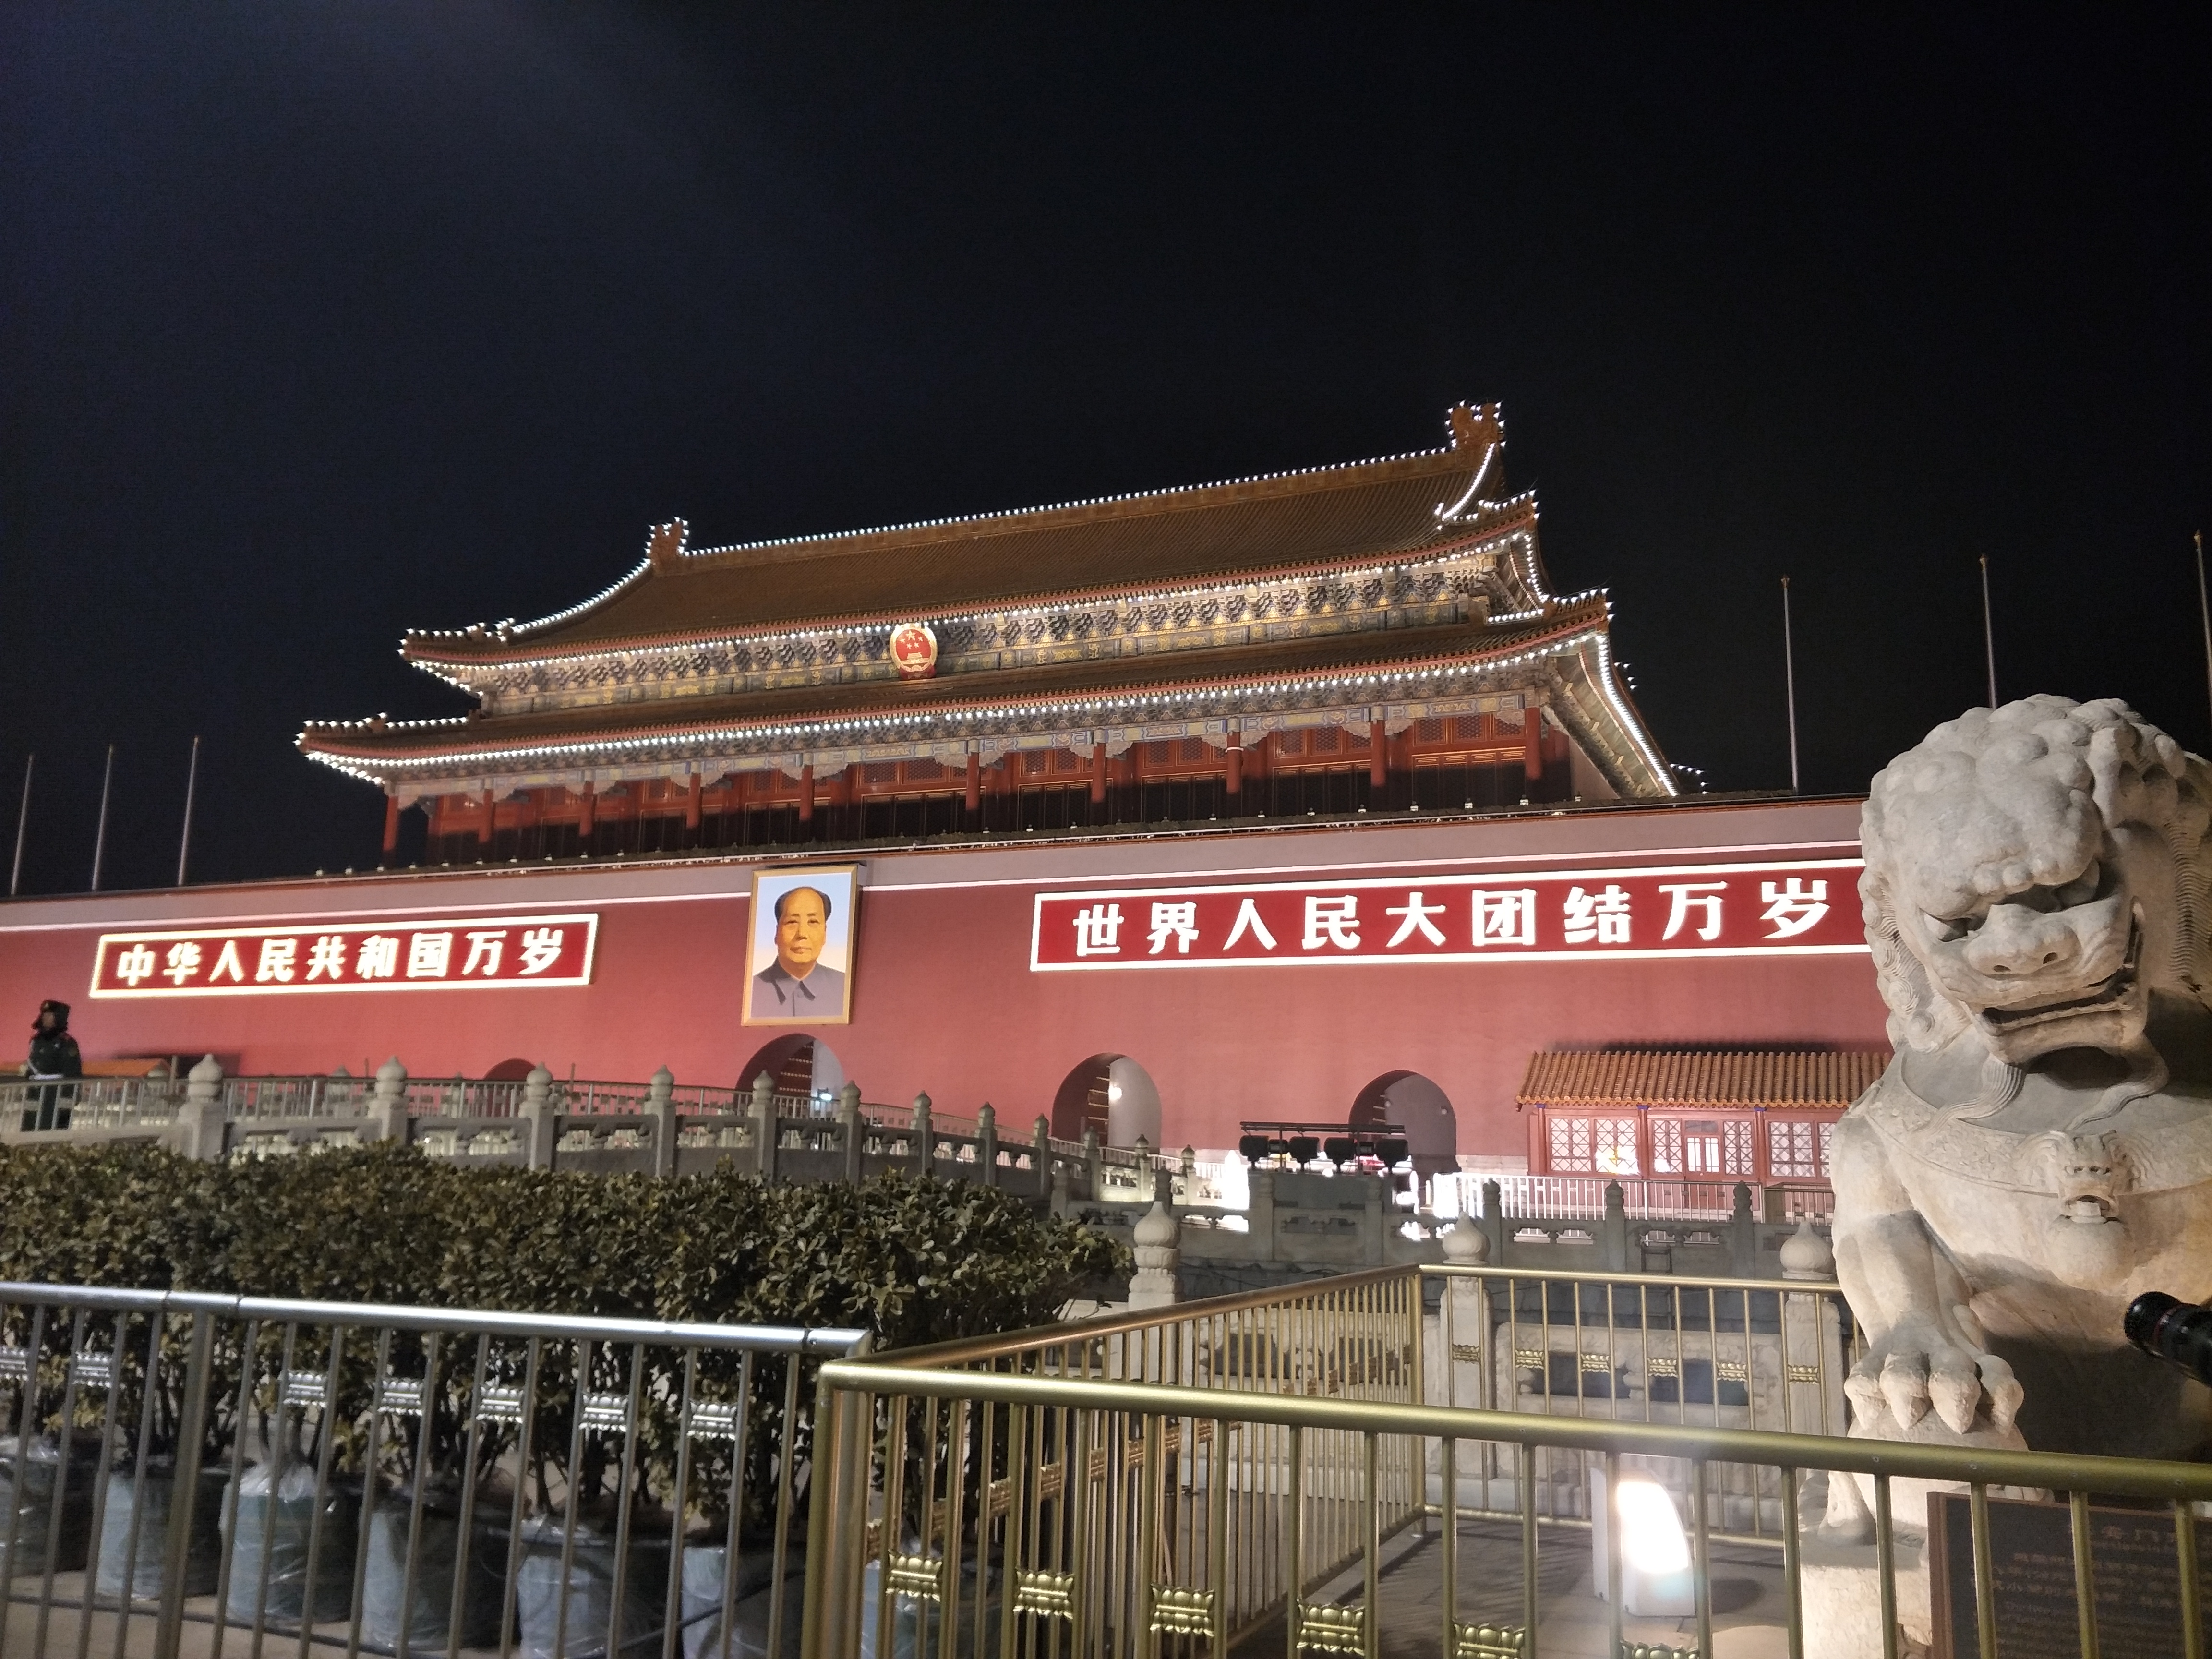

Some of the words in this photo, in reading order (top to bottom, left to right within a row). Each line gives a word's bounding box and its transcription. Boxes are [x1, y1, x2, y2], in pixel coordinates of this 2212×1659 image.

[1072, 878, 1830, 957] 世界人民大团结万岁
[117, 927, 564, 987] 中华人民共和国万岁
